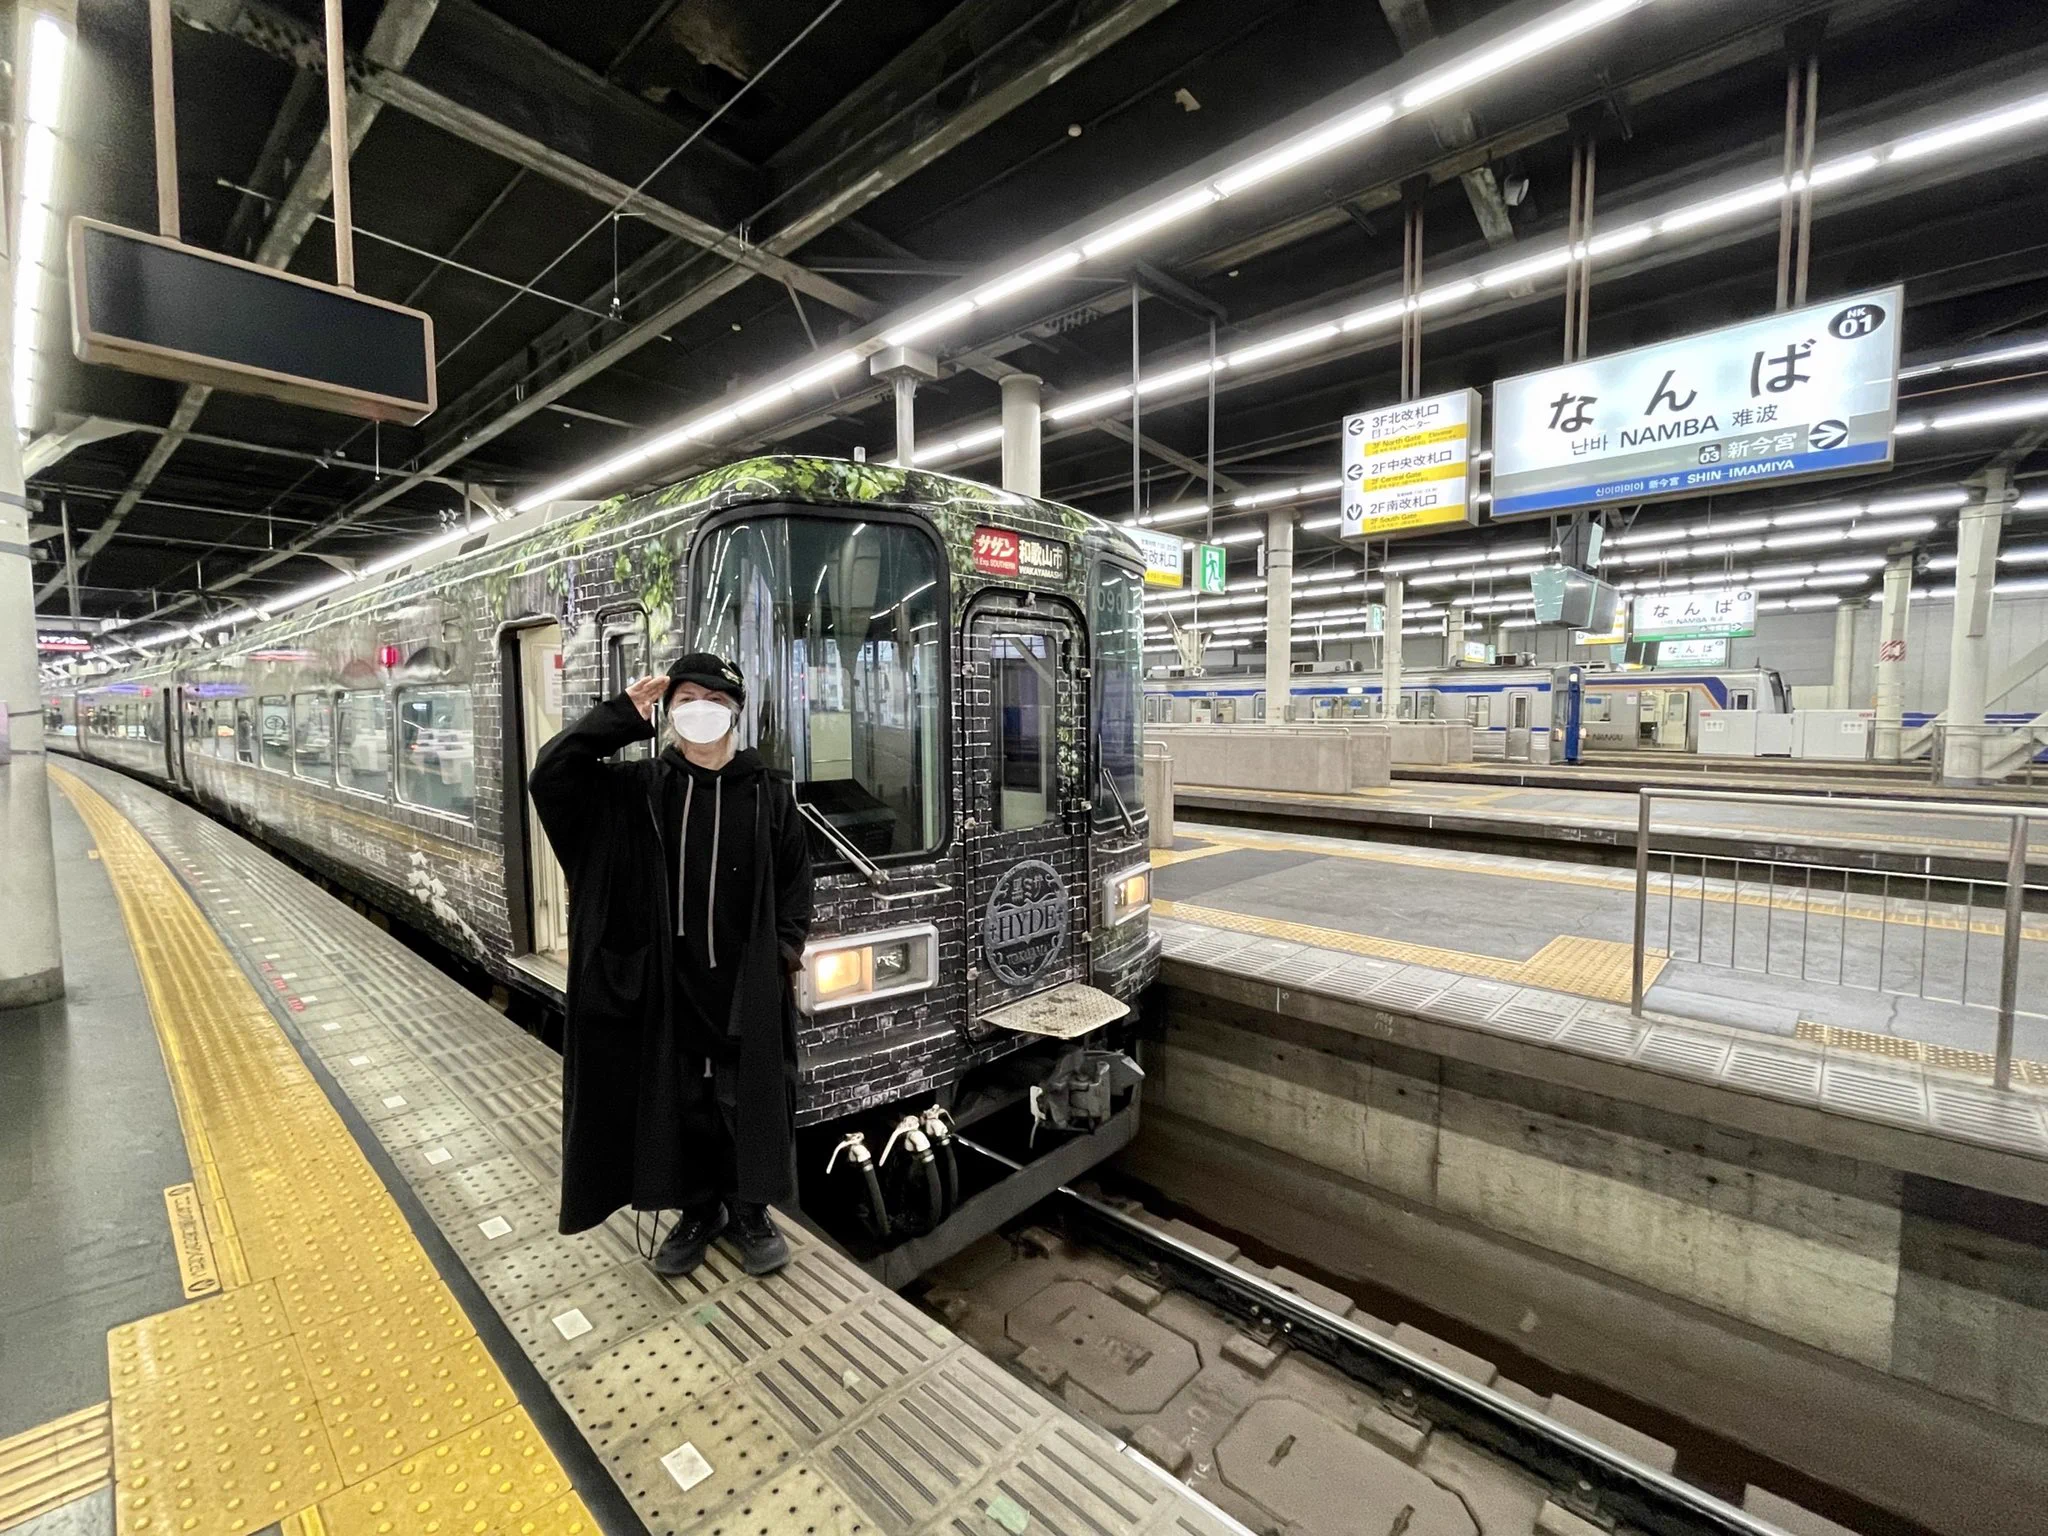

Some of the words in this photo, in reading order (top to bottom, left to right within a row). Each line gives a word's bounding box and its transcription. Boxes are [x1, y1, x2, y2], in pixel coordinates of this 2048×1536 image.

[1846, 307, 1866, 320] NK
[1838, 314, 1873, 338] 01
[1547, 338, 1817, 433] なんば
[1371, 403, 1439, 428] 3F北改札口
[1382, 438, 1404, 447] North
[1405, 434, 1422, 443] Gate
[1571, 435, 1609, 456] 난바
[1620, 415, 1720, 448] NAMBA
[1732, 404, 1778, 427] 难波
[1700, 451, 1720, 463] 03
[1727, 432, 1797, 459] 新今宮
[1371, 450, 1452, 475] 2F中央改札口
[1381, 473, 1404, 484] Central
[1406, 471, 1422, 480] Gate
[1370, 494, 1437, 514] 2F南改札口
[1379, 515, 1400, 523] South
[1401, 512, 1418, 520] Gate
[975, 534, 1015, 557] サザン
[1018, 539, 1064, 570] 和歌山市
[1653, 600, 1734, 618] なんば
[997, 905, 1058, 942] HYDE
